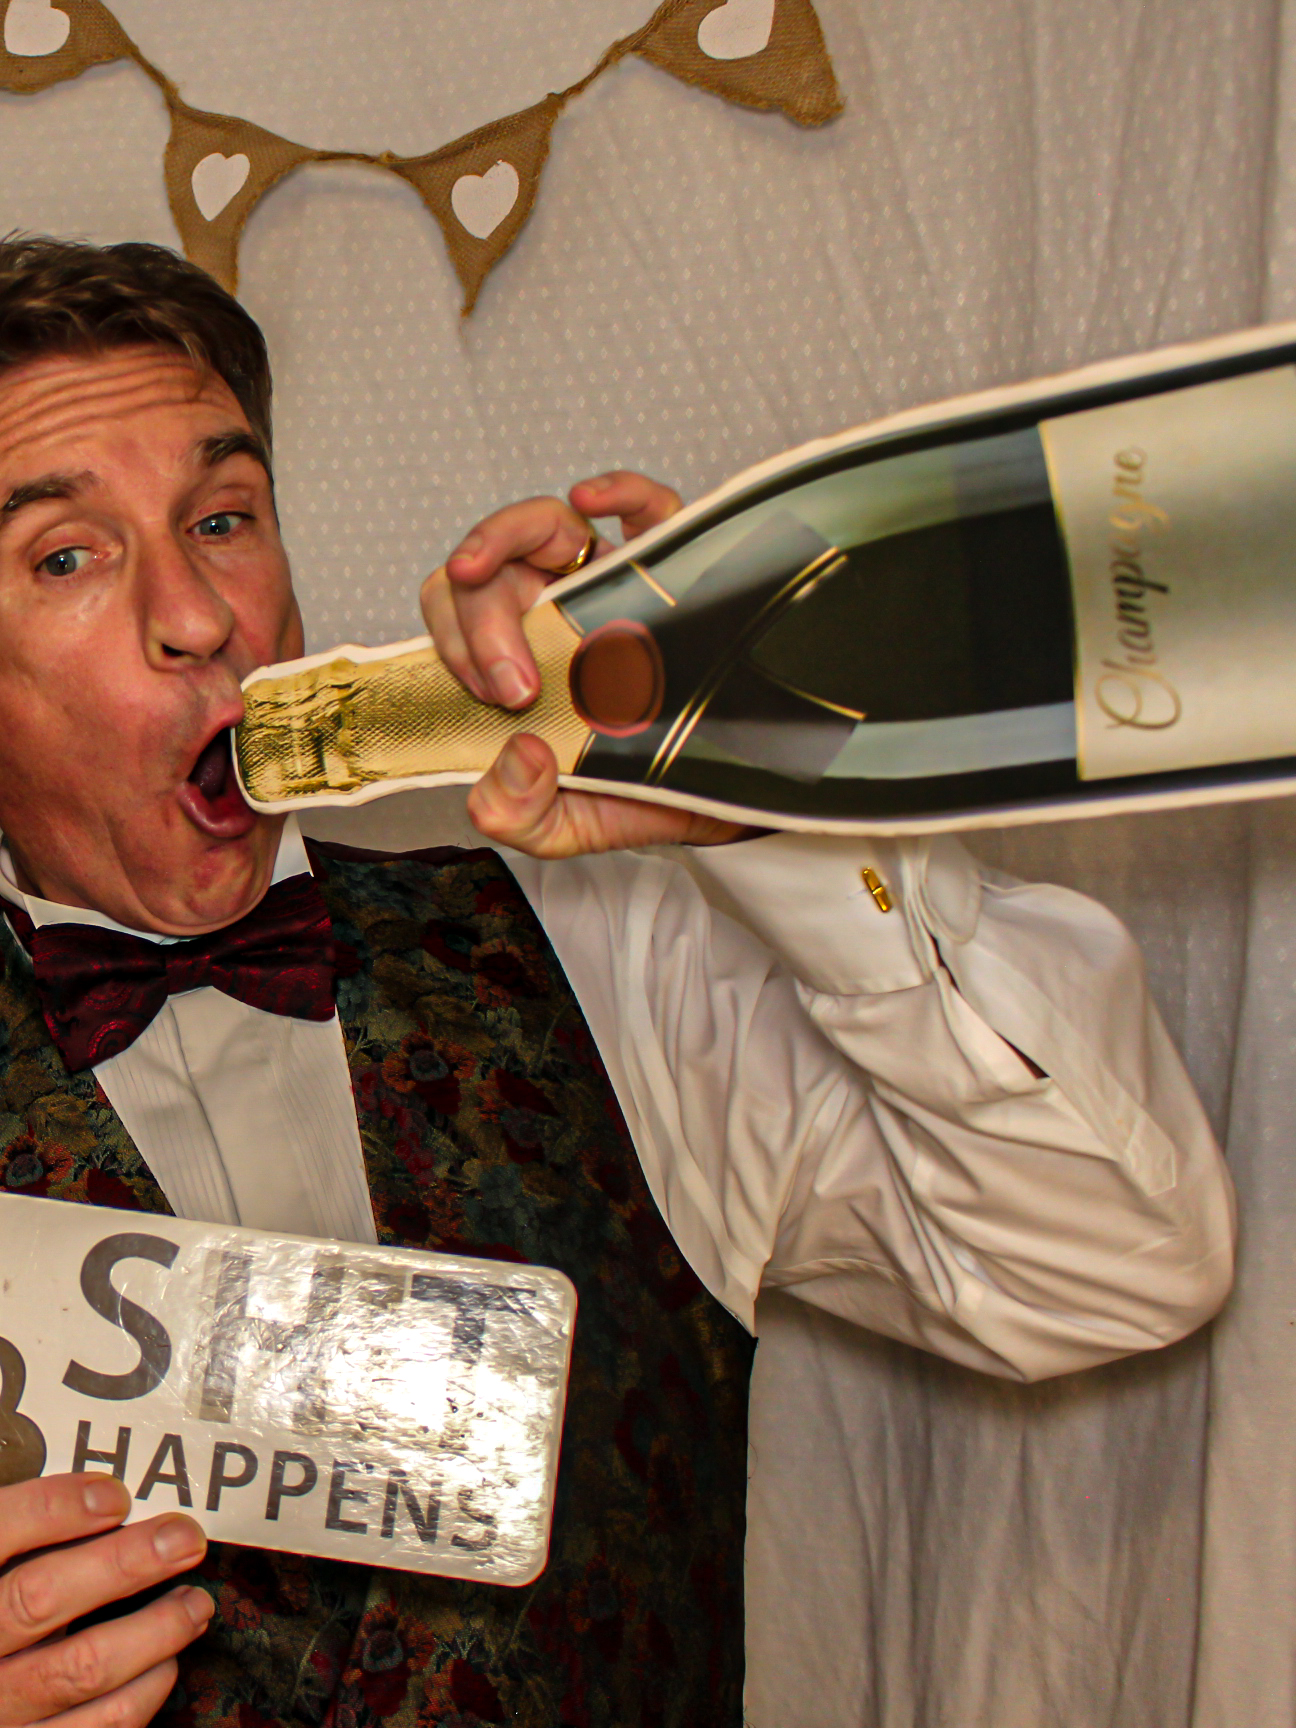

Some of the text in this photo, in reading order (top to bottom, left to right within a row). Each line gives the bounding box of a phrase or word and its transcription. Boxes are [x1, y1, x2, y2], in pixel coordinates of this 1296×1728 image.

[1094, 446, 1183, 731] Champagne
[61, 1231, 539, 1436] SHT
[70, 1419, 500, 1552] HAPPENS
